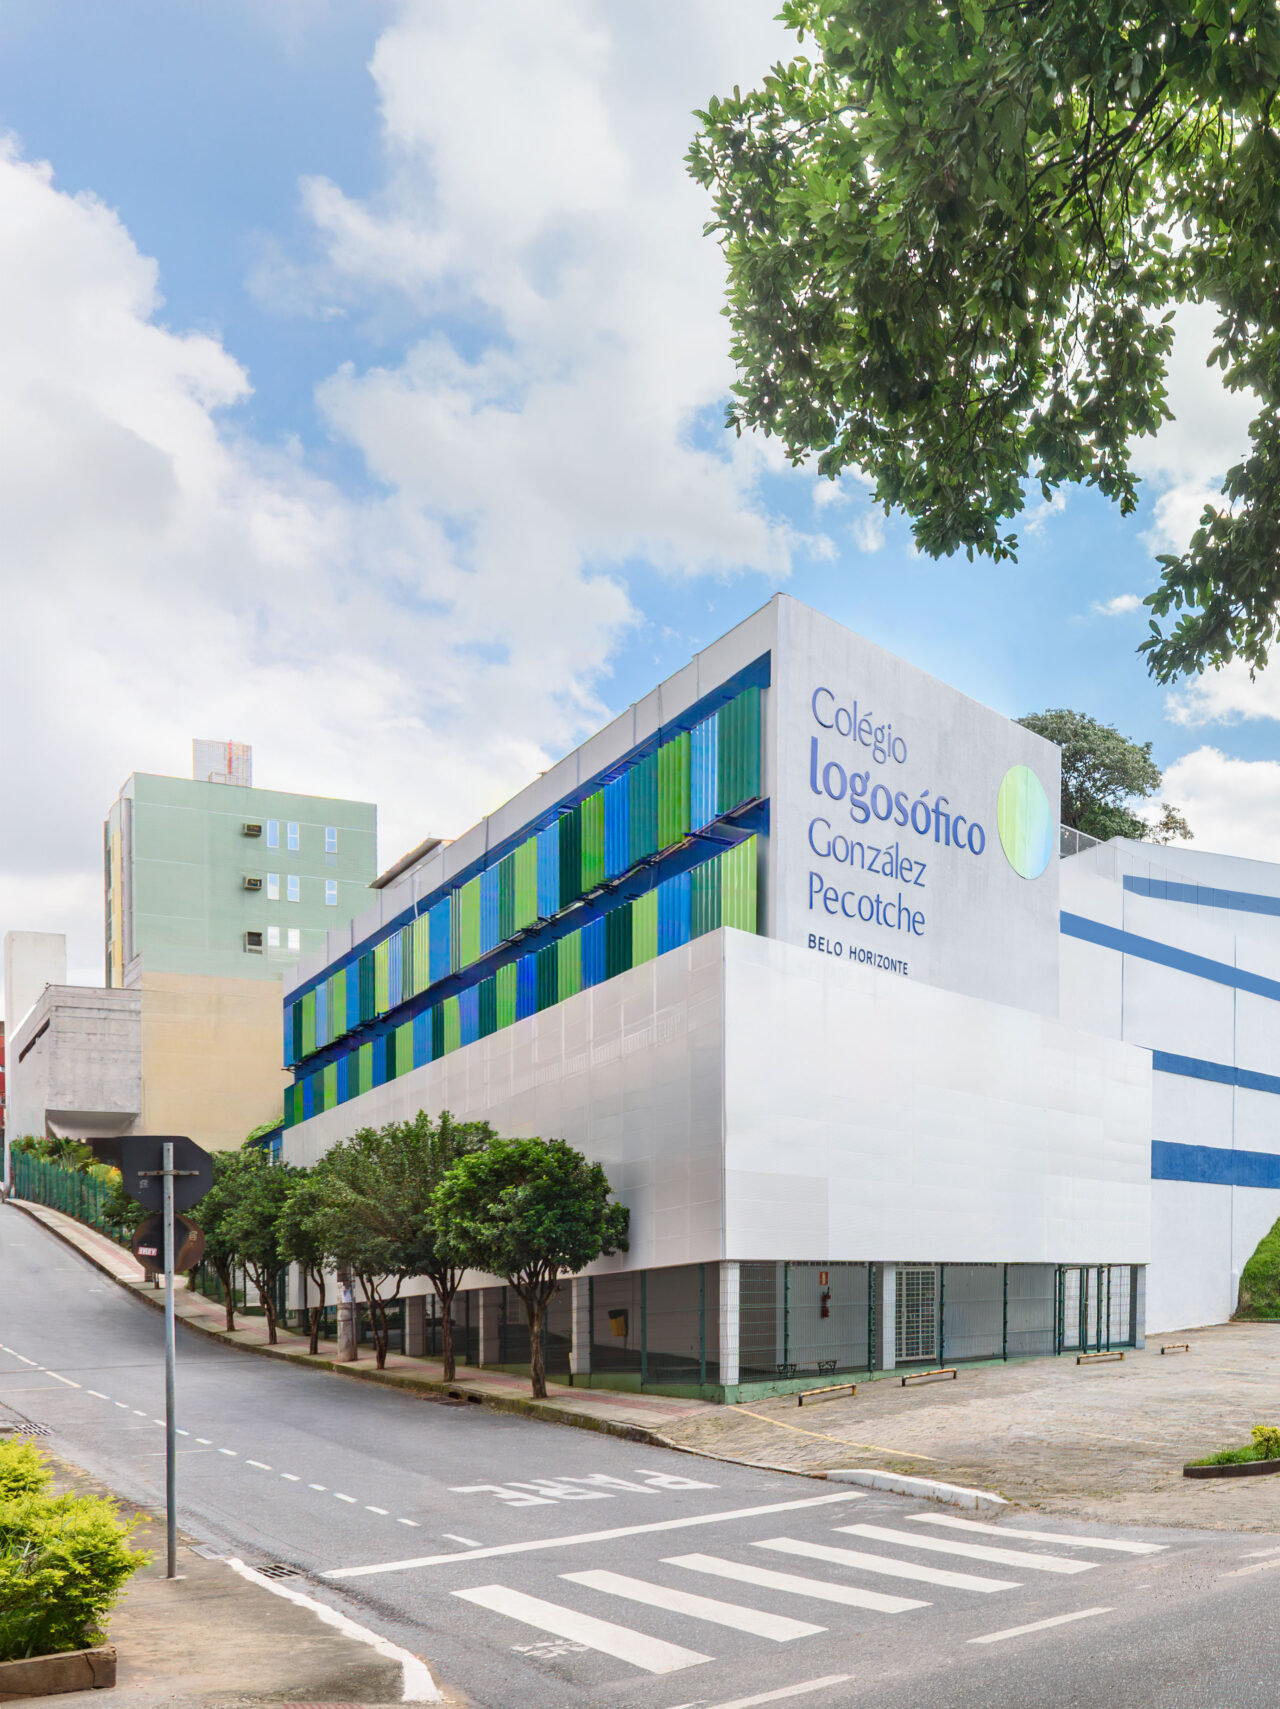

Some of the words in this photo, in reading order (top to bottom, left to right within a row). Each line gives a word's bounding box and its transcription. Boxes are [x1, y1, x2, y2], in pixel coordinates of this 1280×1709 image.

[811, 686, 907, 764] Colégio
[810, 736, 986, 855] logosófico
[808, 817, 927, 887] González
[808, 871, 926, 936] Pecotche
[808, 933, 843, 957] BELO
[849, 945, 908, 975] HORIZONTE
[447, 1469, 721, 1507] PARE
